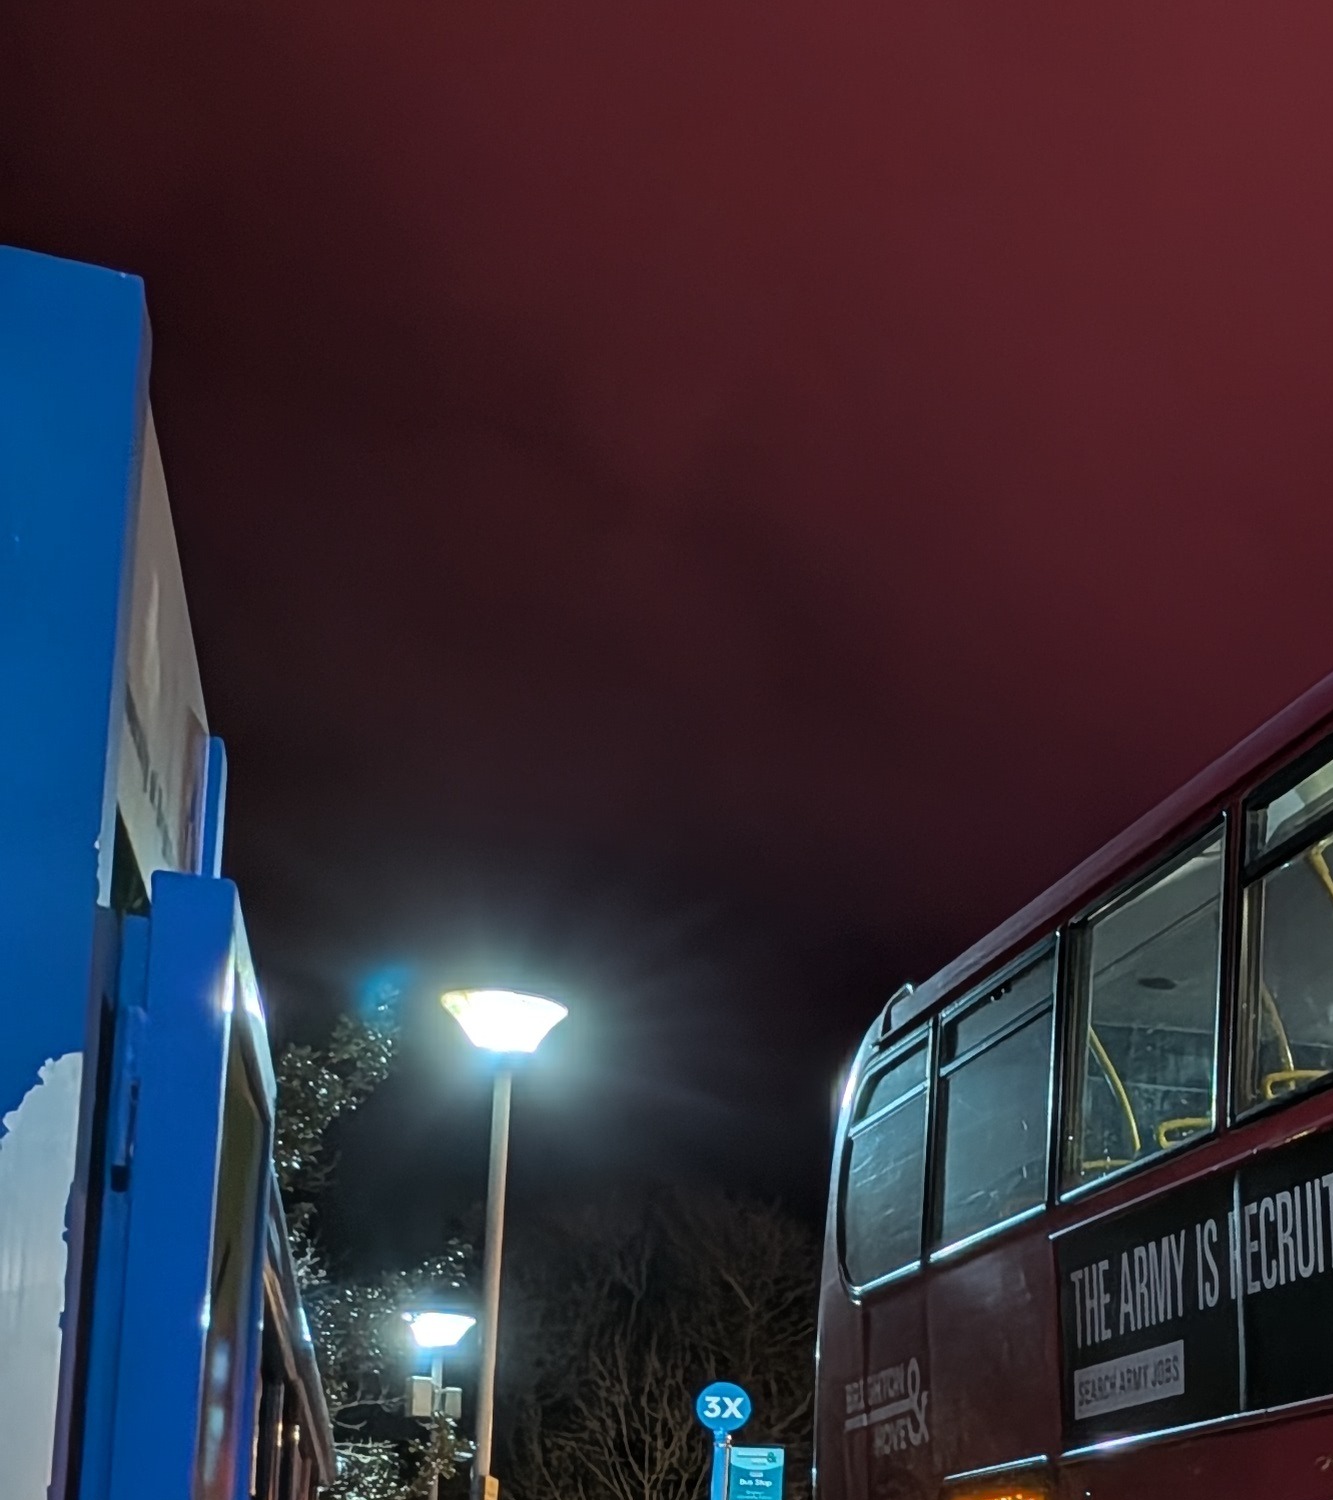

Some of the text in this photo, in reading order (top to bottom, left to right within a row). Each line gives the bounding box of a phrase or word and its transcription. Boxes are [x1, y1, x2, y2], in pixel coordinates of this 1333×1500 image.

[1070, 1258, 1112, 1349] THE
[1118, 1229, 1186, 1335] ARMY
[1195, 1218, 1220, 1311] IS
[703, 1395, 744, 1419] 3X
